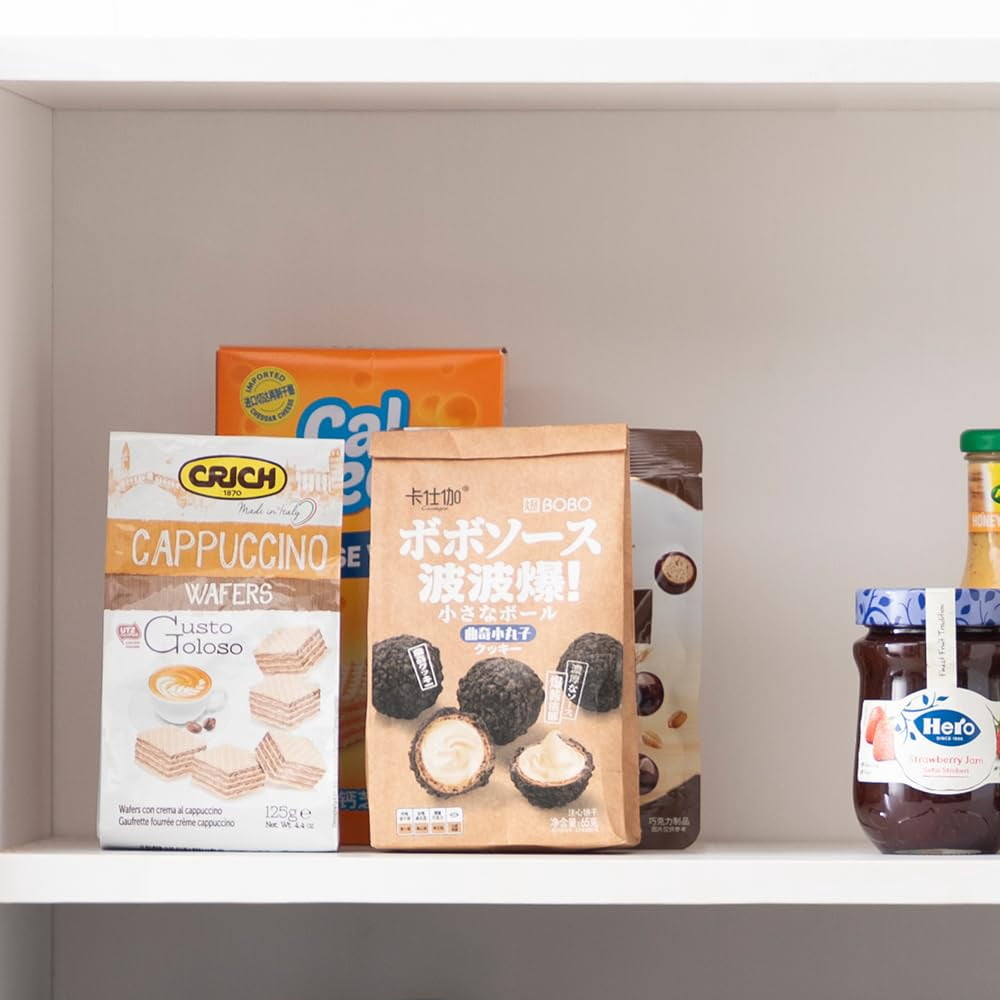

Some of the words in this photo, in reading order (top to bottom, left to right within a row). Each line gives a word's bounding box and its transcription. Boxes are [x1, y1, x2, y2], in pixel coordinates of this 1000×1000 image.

[245, 370, 286, 392] IMPORTED
[189, 465, 276, 490] CRICH
[238, 502, 264, 513] Made
[542, 496, 592, 512] BOBO
[400, 516, 602, 561] ボボソース
[131, 527, 328, 571] CAPPUCCINO
[185, 582, 273, 605] WAFERS
[438, 605, 558, 624] 小さなボール
[464, 626, 532, 642] 曲奇小丸子
[475, 642, 523, 656] クッキー
[923, 717, 976, 736] Hero
[911, 755, 962, 768] trawberry
[964, 755, 984, 766] Jam
[118, 804, 140, 814] Wafers
[142, 806, 155, 814] con
[156, 806, 177, 814] crema
[178, 805, 184, 814] al
[185, 806, 223, 816] cappuccino
[265, 805, 298, 822] 125g
[118, 816, 150, 826] Gaufrette
[150, 817, 175, 826] fourrée
[175, 817, 196, 827] crème
[197, 818, 235, 828] cappuccino
